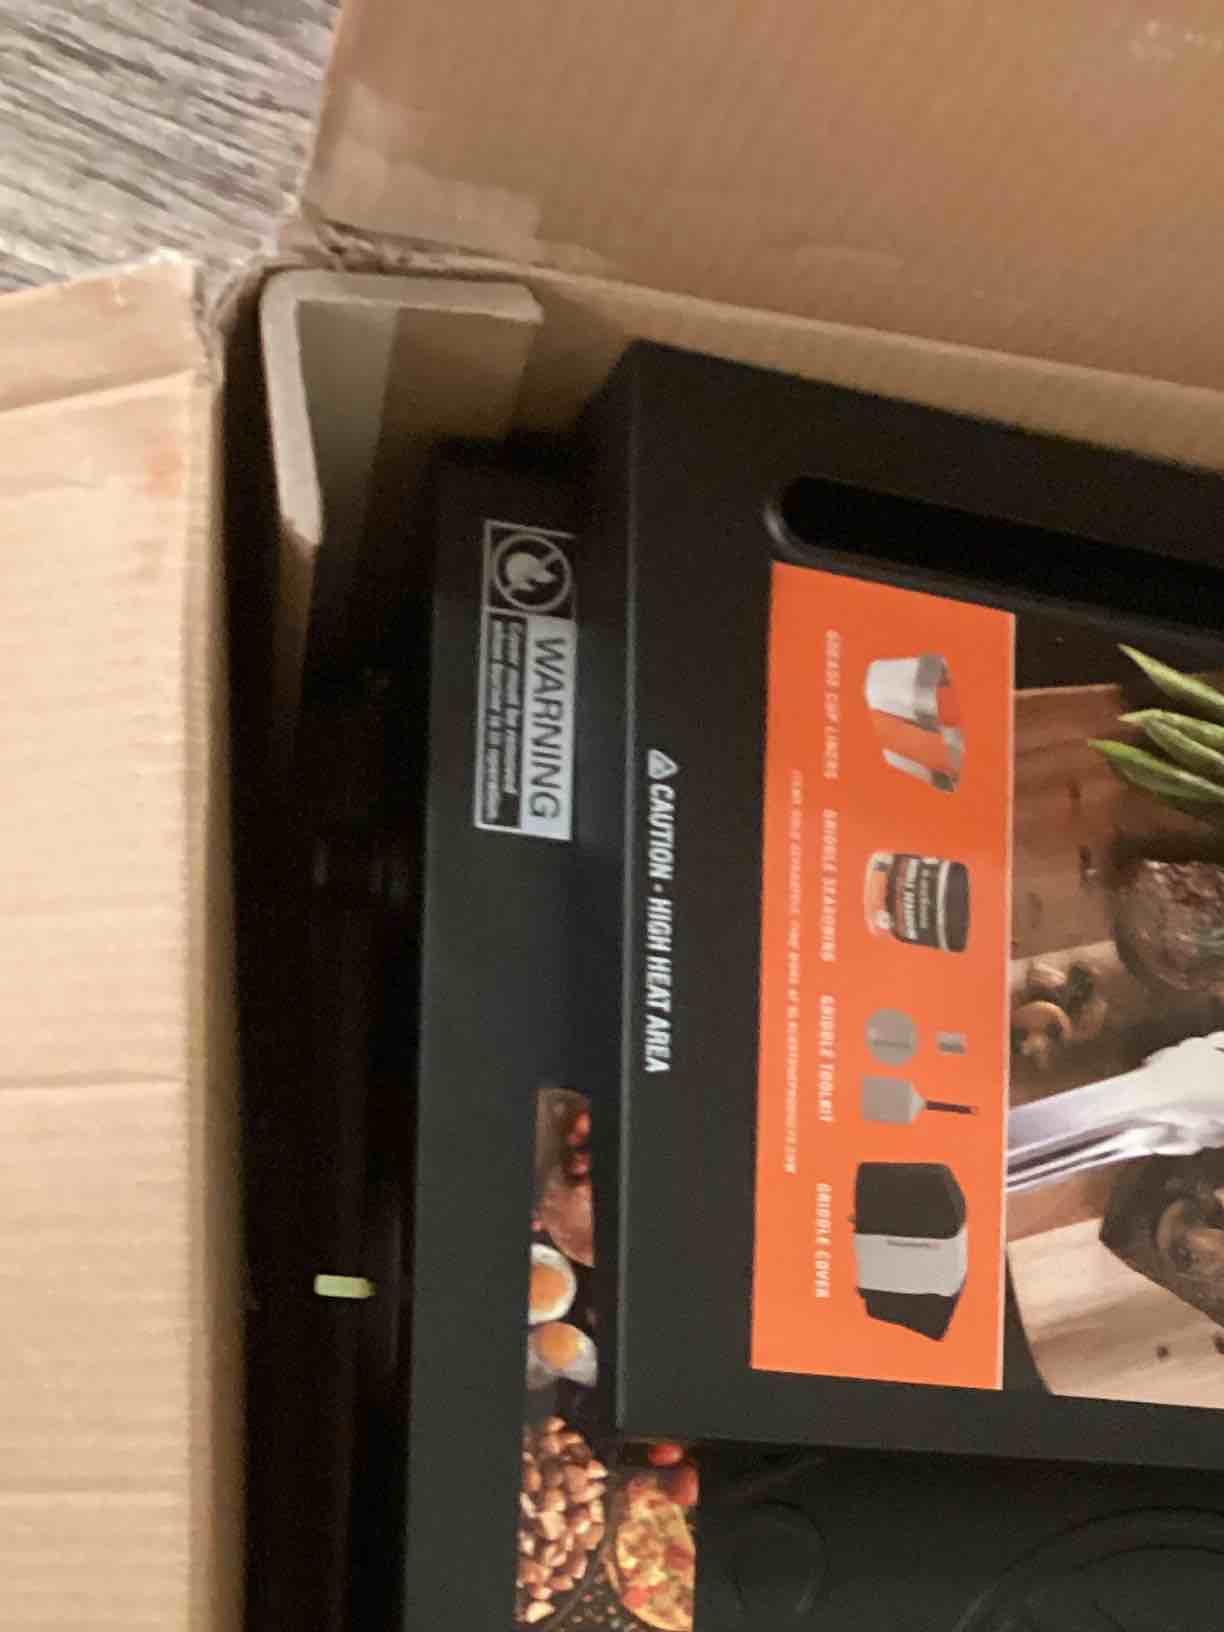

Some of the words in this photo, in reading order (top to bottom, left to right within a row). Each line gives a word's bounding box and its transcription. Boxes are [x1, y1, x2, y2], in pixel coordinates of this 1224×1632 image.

[530, 637, 566, 818] WARNING
[649, 784, 674, 880] CAUTION
[822, 809, 838, 872] GRIDDLE
[647, 897, 673, 951] HIGH
[647, 956, 672, 1012] HEAT
[645, 1014, 670, 1073] AREA
[819, 994, 835, 1057] GRIDDLE
[815, 1183, 832, 1246] GRIDDLE
[814, 1250, 831, 1299] COVER
